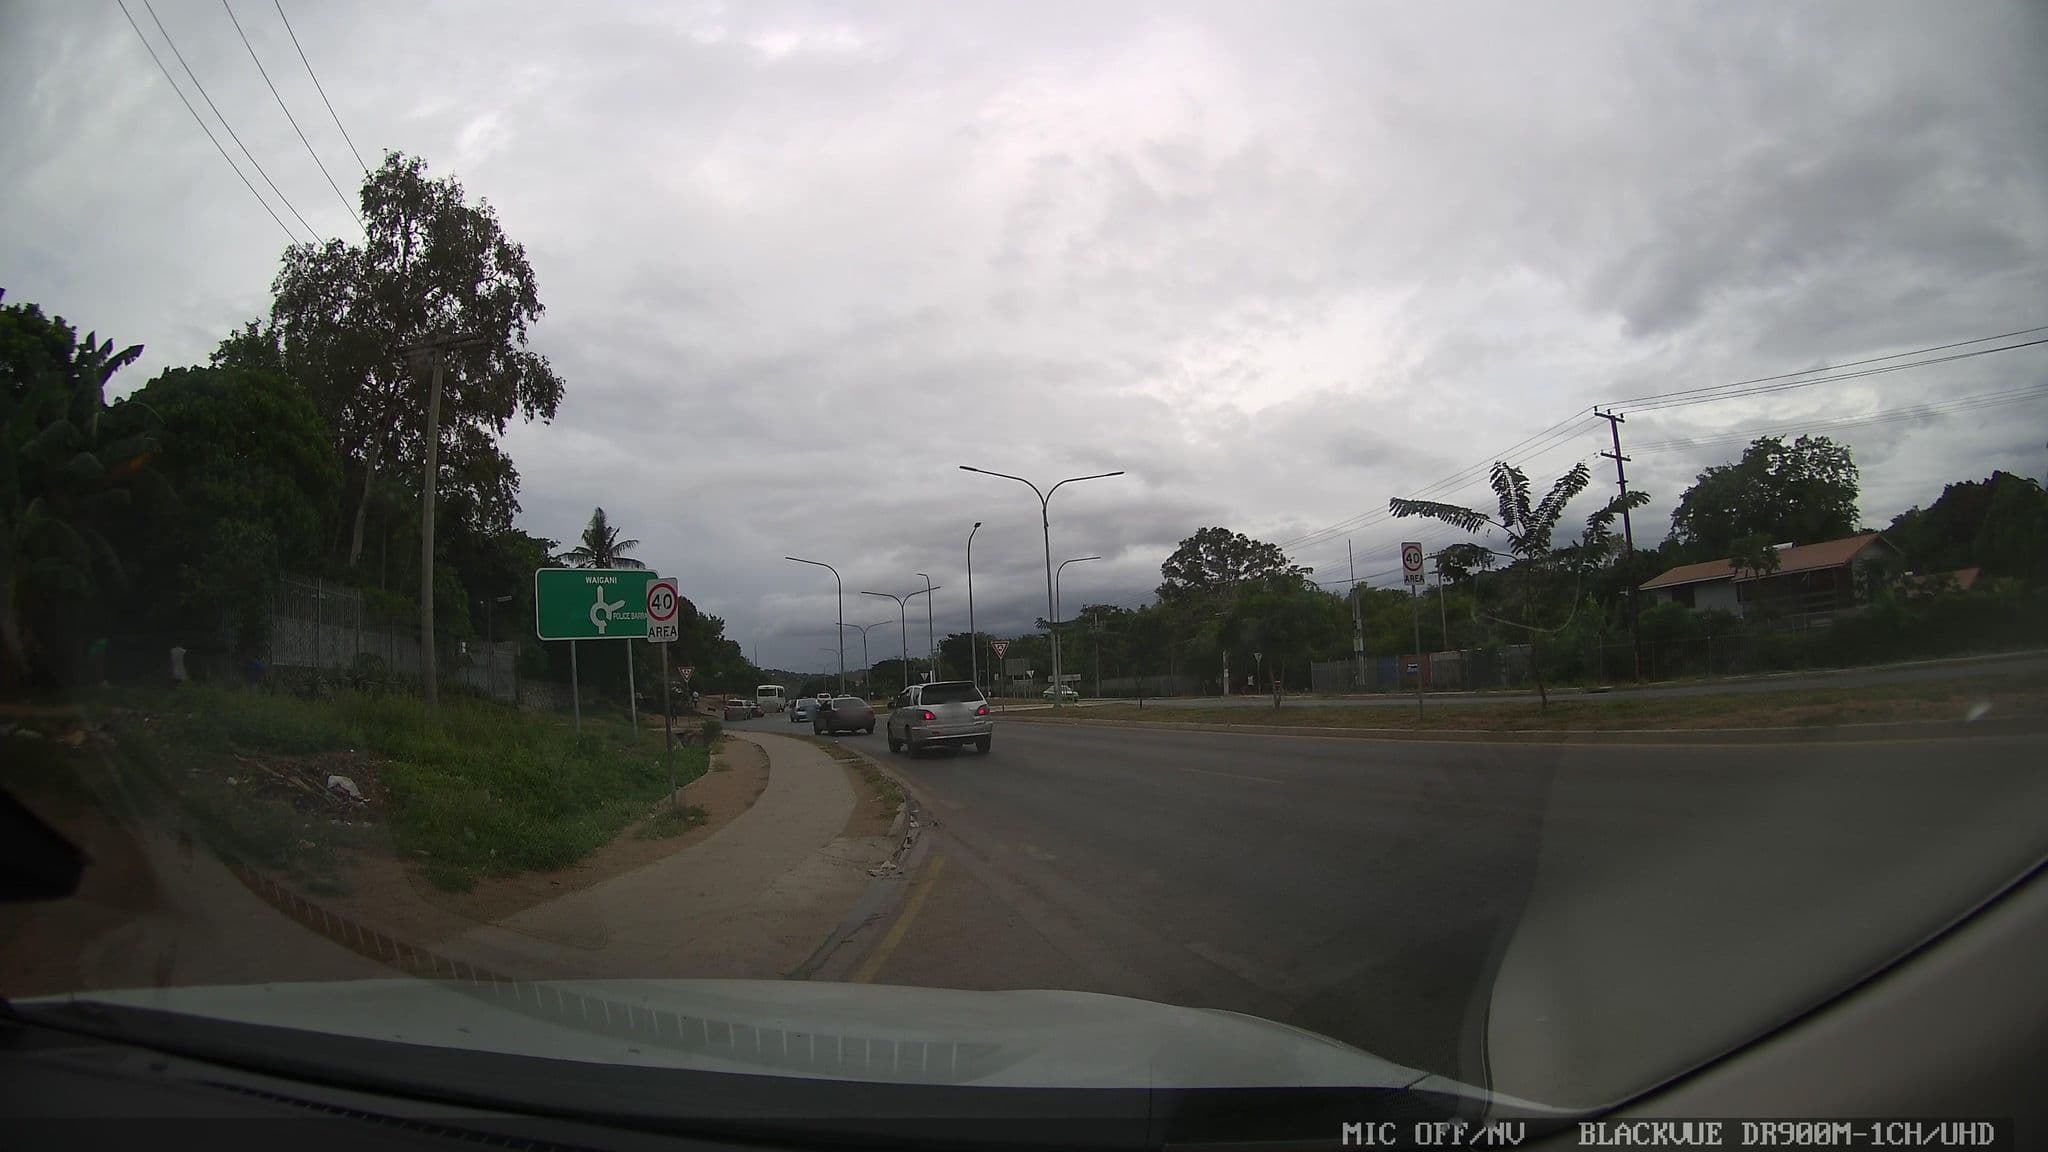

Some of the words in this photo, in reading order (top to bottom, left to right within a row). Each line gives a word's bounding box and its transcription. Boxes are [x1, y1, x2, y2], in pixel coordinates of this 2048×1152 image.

[1406, 552, 1420, 564] 40
[586, 576, 617, 584] WAIGANI
[1405, 574, 1425, 583] AREA
[651, 593, 673, 610] 40
[613, 612, 630, 620] POLICE
[648, 626, 677, 638] AREA
